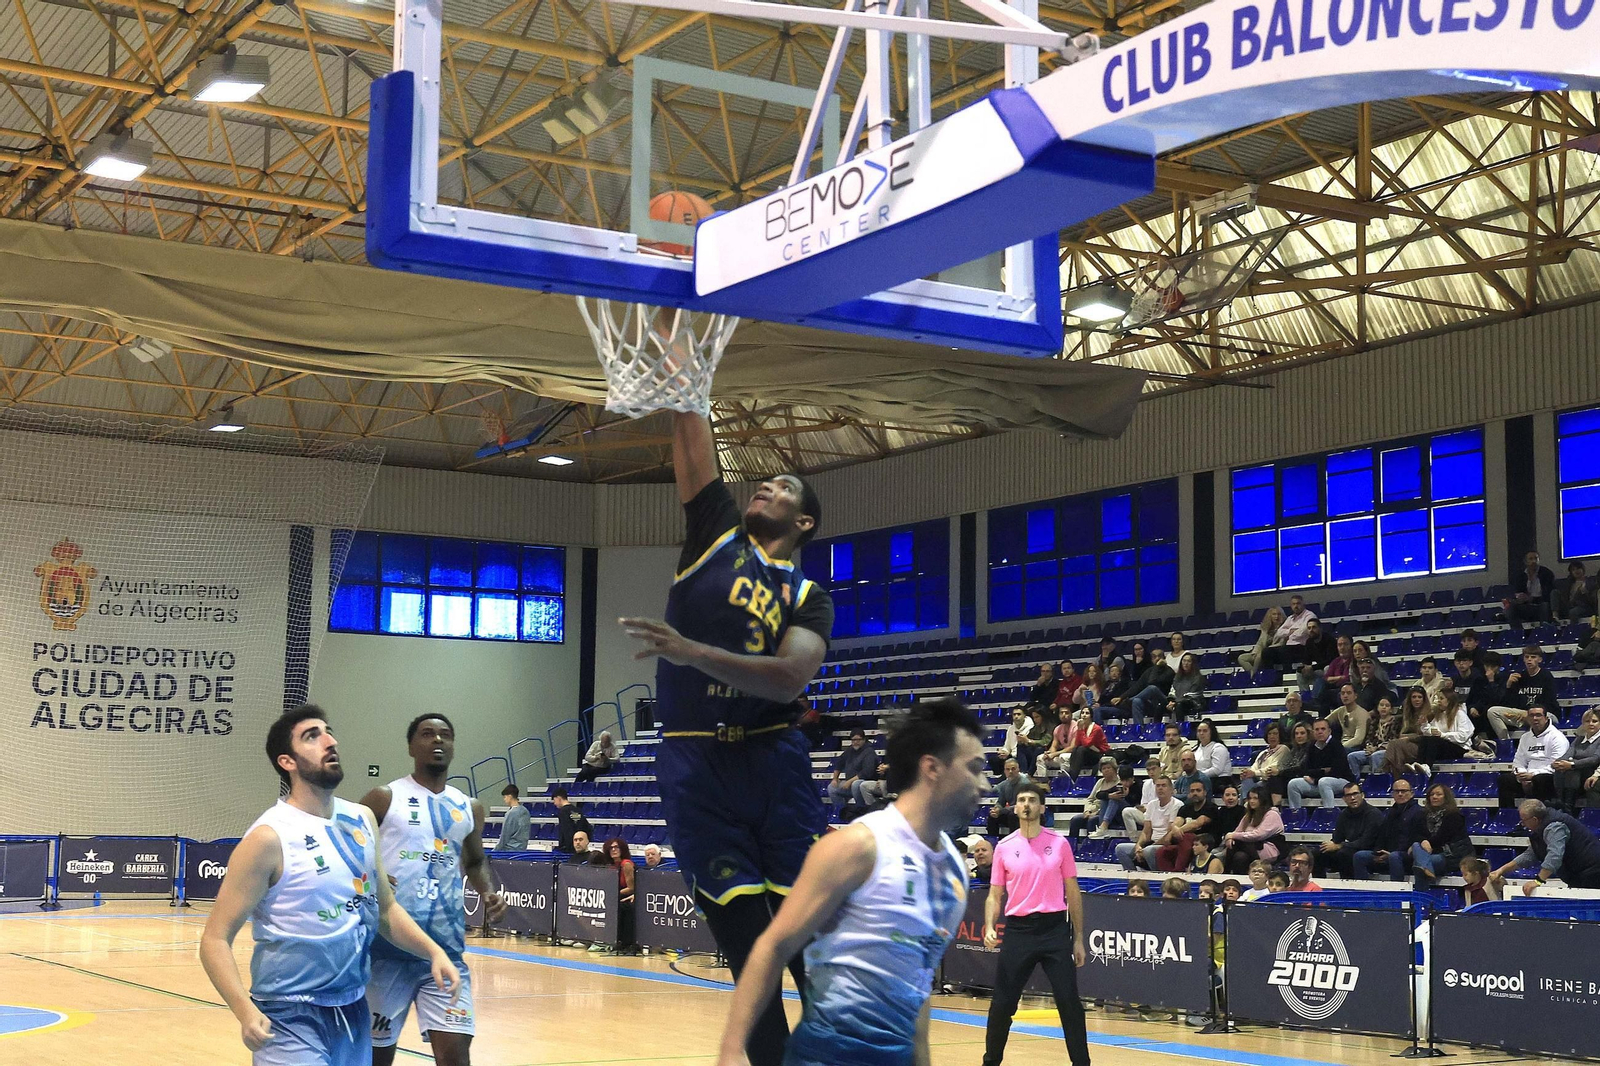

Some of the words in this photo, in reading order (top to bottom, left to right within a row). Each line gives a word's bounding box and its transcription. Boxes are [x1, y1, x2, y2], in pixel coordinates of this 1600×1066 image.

[1102, 21, 1212, 114] CLUB
[782, 204, 890, 261] CENTER
[100, 575, 239, 600] Ayuntamiento
[98, 600, 123, 617] de
[130, 600, 238, 623] Algeciras
[745, 620, 765, 653] 3
[33, 642, 236, 670] POLIDEPORTIVO
[32, 668, 177, 701] CIUDAD
[188, 674, 234, 704] DE
[30, 701, 233, 735] ALGECIRAS
[70, 863, 110, 871] Heineken
[417, 877, 440, 900] 35
[567, 887, 606, 908] IBERSUR
[653, 916, 697, 928] CENTER
[1089, 929, 1192, 962] CENTRAL
[1090, 946, 1165, 970] Apartamentos
[1288, 951, 1335, 963] ZAHARA
[1267, 960, 1360, 991] 2000
[1460, 970, 1524, 996] surpool
[1540, 978, 1582, 993] IRENE
